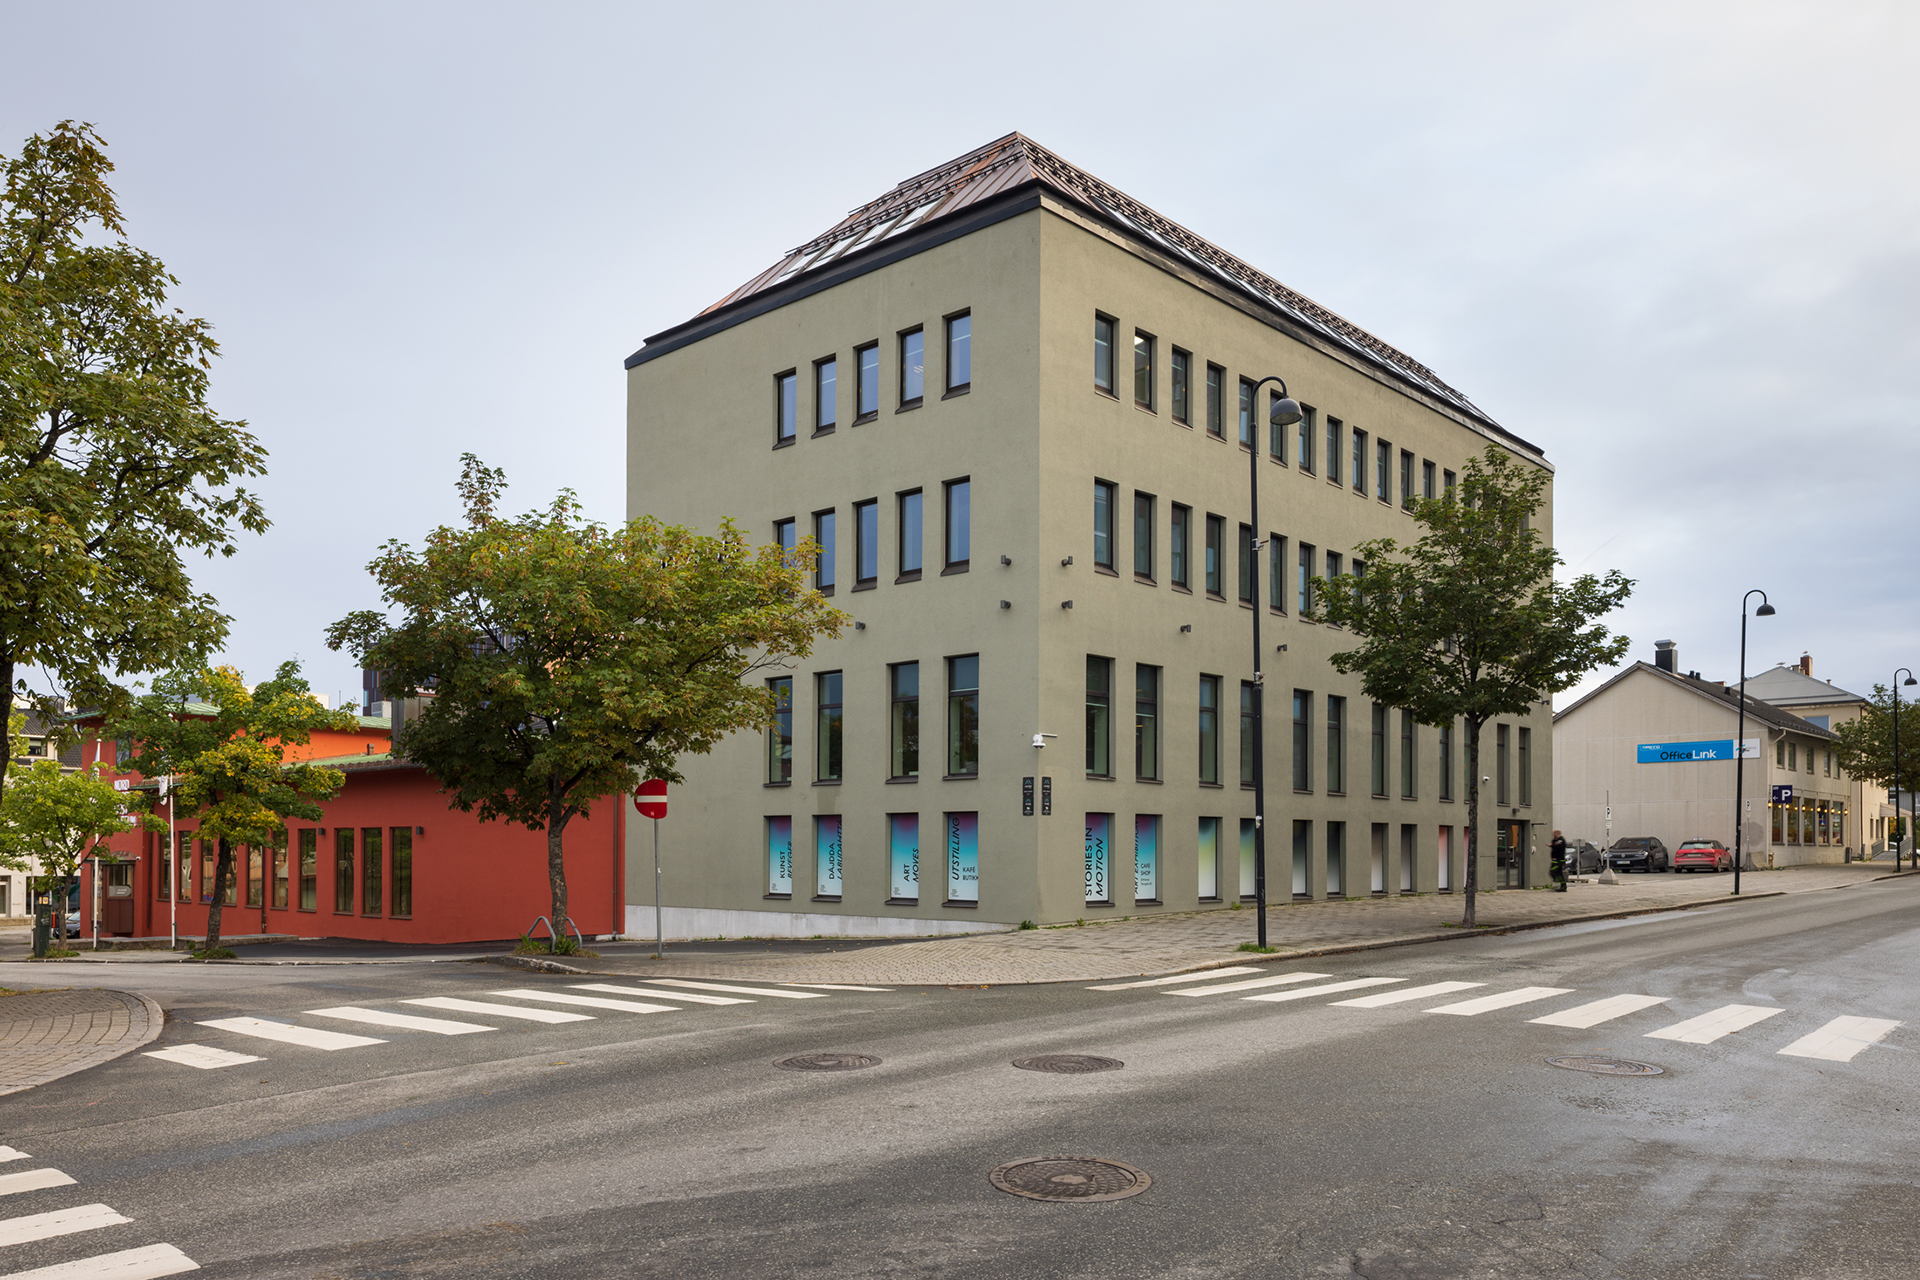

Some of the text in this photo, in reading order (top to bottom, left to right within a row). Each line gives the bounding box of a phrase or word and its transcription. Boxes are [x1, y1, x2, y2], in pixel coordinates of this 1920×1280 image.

[1660, 749, 1717, 760] OfficeLink
[1782, 790, 1791, 801] P
[1085, 827, 1092, 841] IN
[952, 816, 960, 881] UTSTILLING
